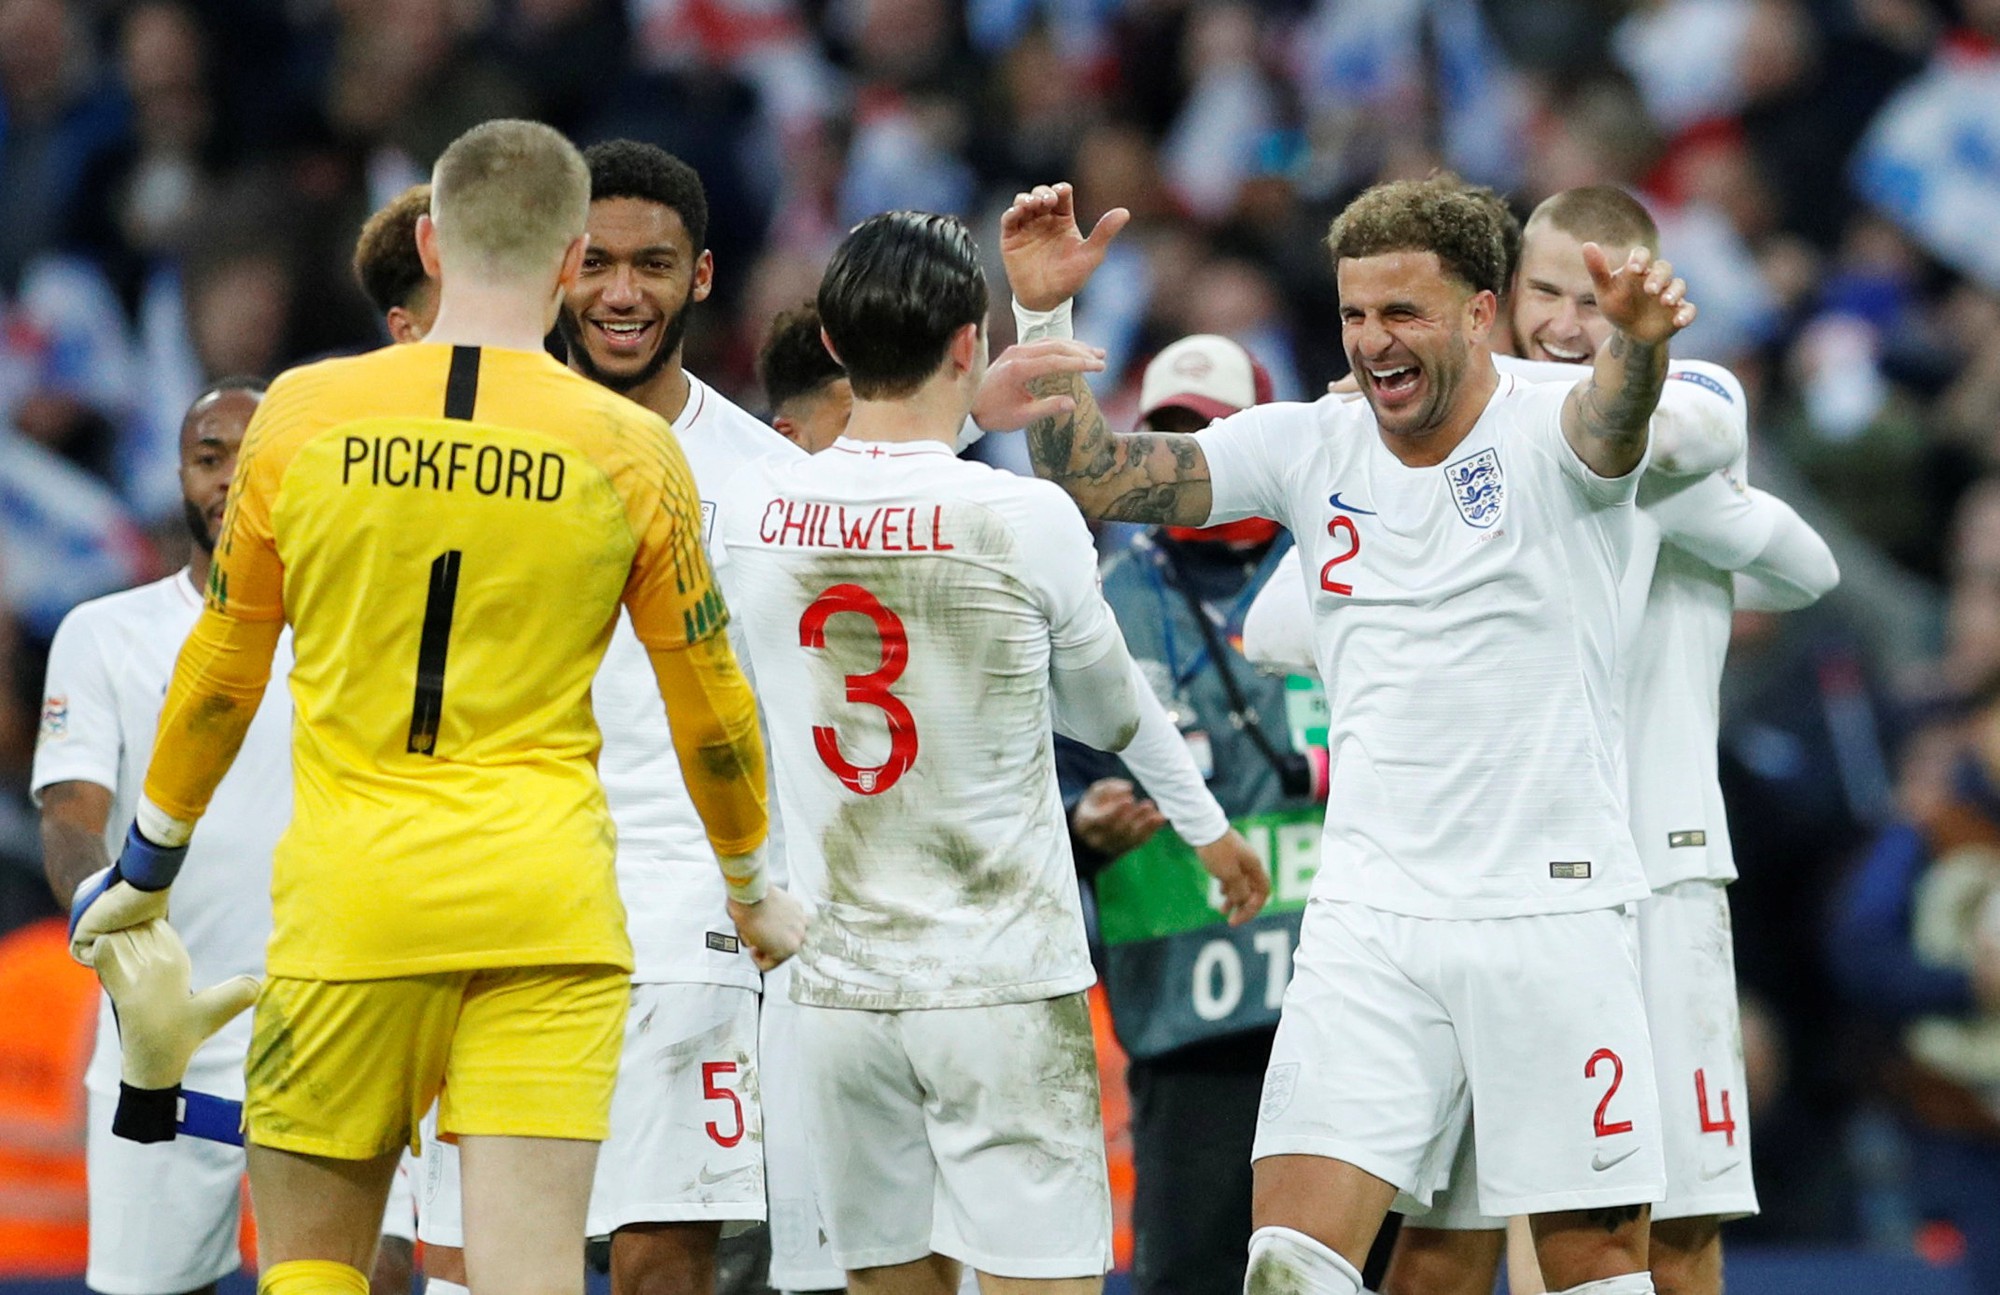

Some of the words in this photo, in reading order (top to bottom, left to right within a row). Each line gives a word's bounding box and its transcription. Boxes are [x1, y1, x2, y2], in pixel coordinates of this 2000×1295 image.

[343, 437, 565, 502] PICKFORD
[760, 498, 954, 551] CHILWELL
[1320, 515, 1360, 597] 2
[407, 549, 462, 757] 1
[799, 583, 918, 796] 3
[702, 1061, 745, 1148] 5
[1584, 1048, 1633, 1138] 2
[1694, 1068, 1736, 1147] 4
